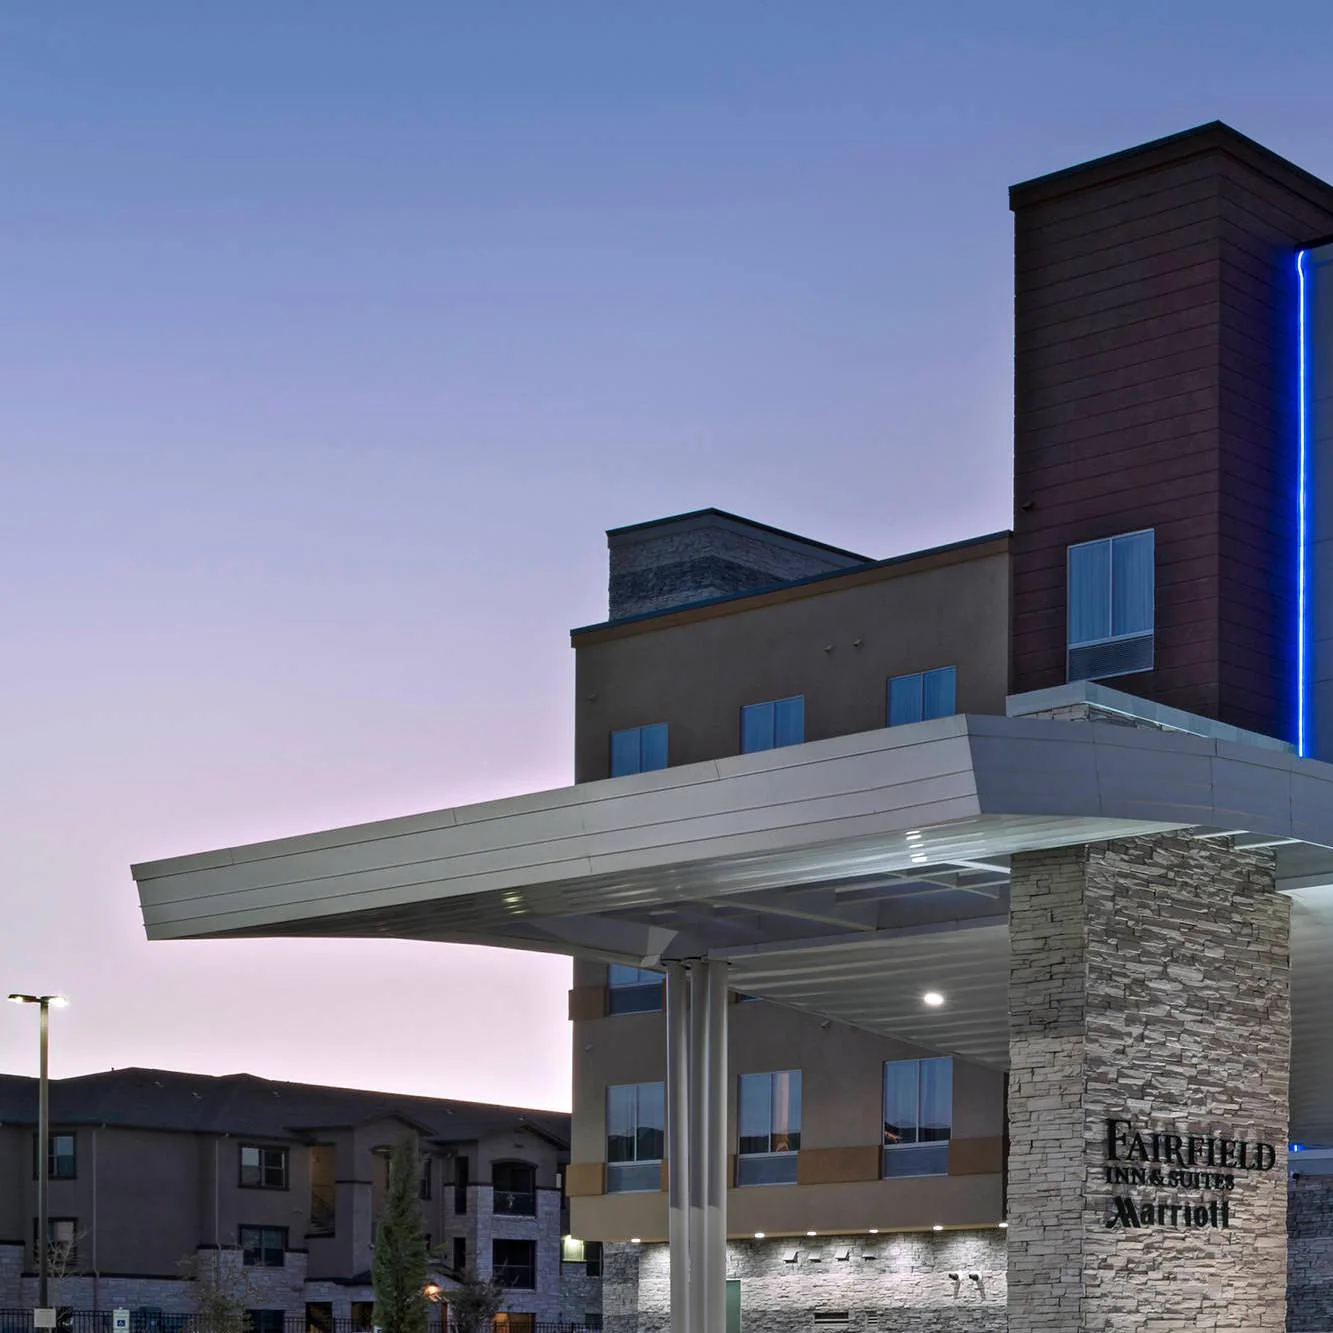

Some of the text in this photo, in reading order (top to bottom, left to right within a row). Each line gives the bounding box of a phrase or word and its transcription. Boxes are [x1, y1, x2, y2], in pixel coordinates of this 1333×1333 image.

[1106, 1118, 1276, 1171] FAIRFIELD
[1105, 1166, 1147, 1185] INN
[1169, 1171, 1235, 1191] SUITES
[1105, 1196, 1230, 1229] Marriott
